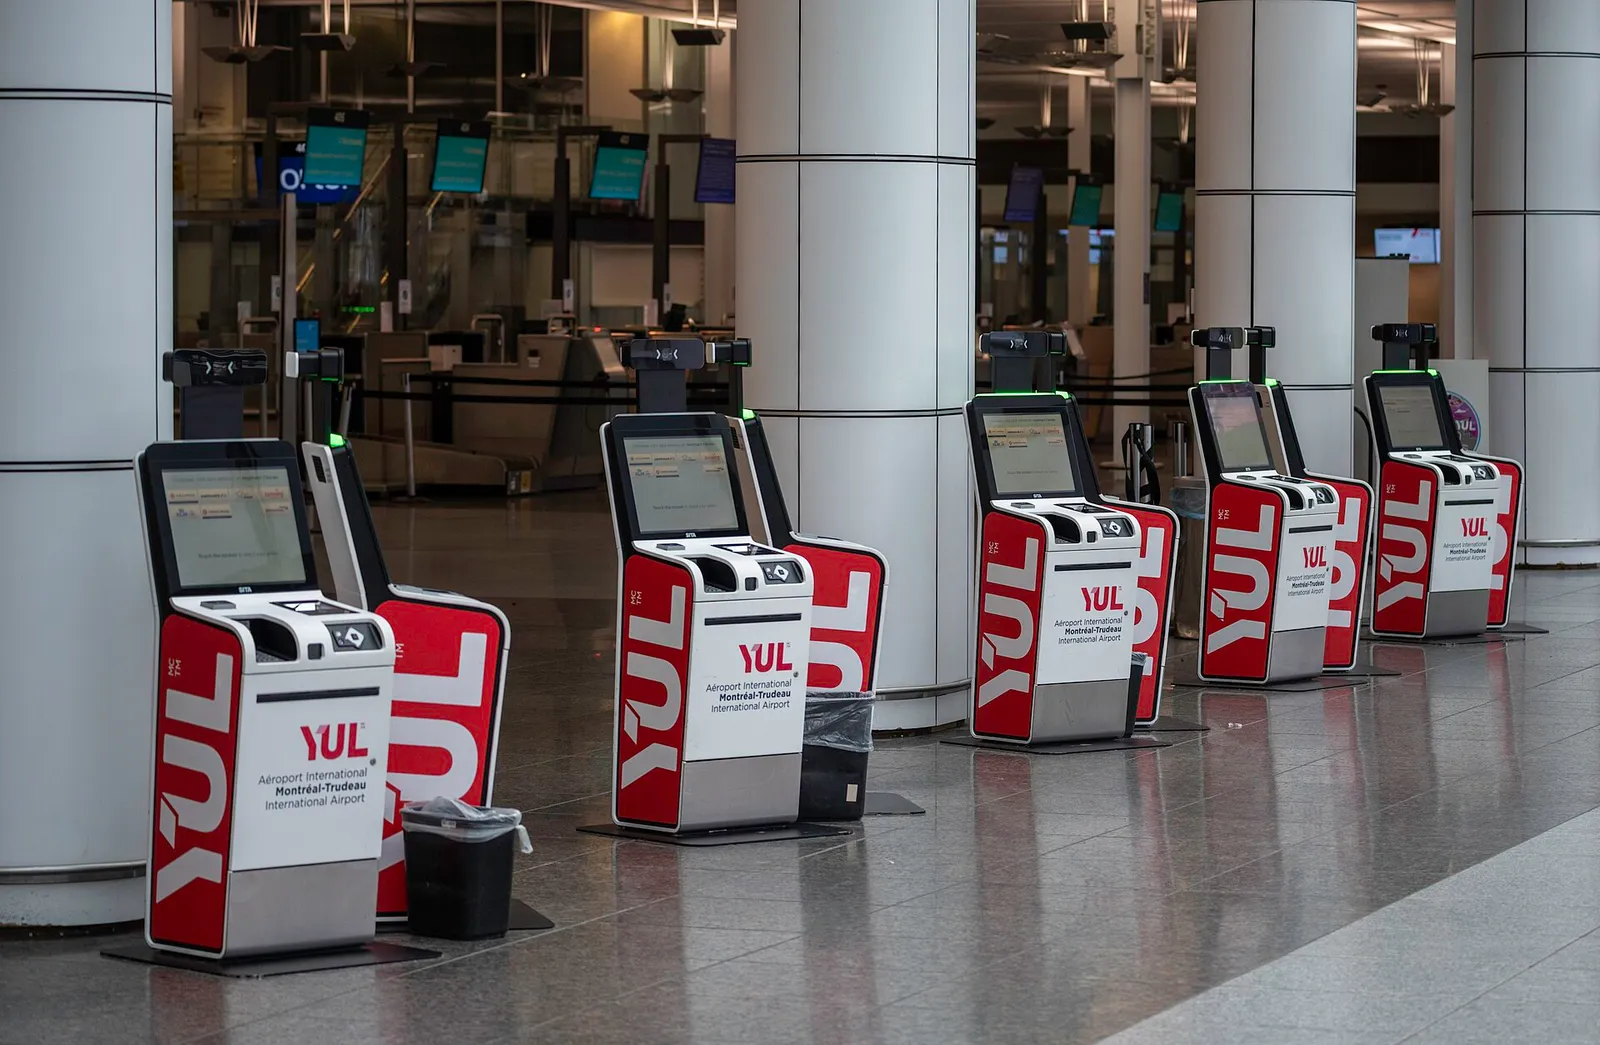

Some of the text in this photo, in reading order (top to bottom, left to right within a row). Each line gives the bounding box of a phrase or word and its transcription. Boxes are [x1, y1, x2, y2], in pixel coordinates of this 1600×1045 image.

[1218, 509, 1224, 520] MC
[1224, 509, 1230, 520] TM
[1461, 517, 1488, 537] YUL
[988, 541, 994, 554] MC
[994, 542, 999, 554] TM
[1377, 480, 1431, 612] YUL
[1303, 546, 1326, 568] YUL
[1207, 504, 1275, 655] YUL
[631, 590, 637, 605] MC
[637, 591, 642, 605] TM
[1081, 586, 1124, 612] YUL
[978, 537, 1039, 709] YUL
[1064, 625, 1122, 635] Montréal-Trudeau
[1084, 617, 1123, 625] International
[1058, 634, 1121, 644] International Airport
[738, 642, 793, 673] YUL
[168, 657, 175, 677] MC
[175, 658, 182, 677] TM
[621, 585, 686, 790] YUL
[705, 679, 792, 692] Aéroport International
[719, 690, 791, 702] Montréal-Trudeau
[711, 700, 790, 713] International Airport
[300, 722, 368, 761] YUL
[156, 652, 234, 904] YUL
[258, 767, 368, 785] Aéroport International
[275, 781, 367, 797] Montréal-Trudeau
[265, 793, 366, 811] International Airport
